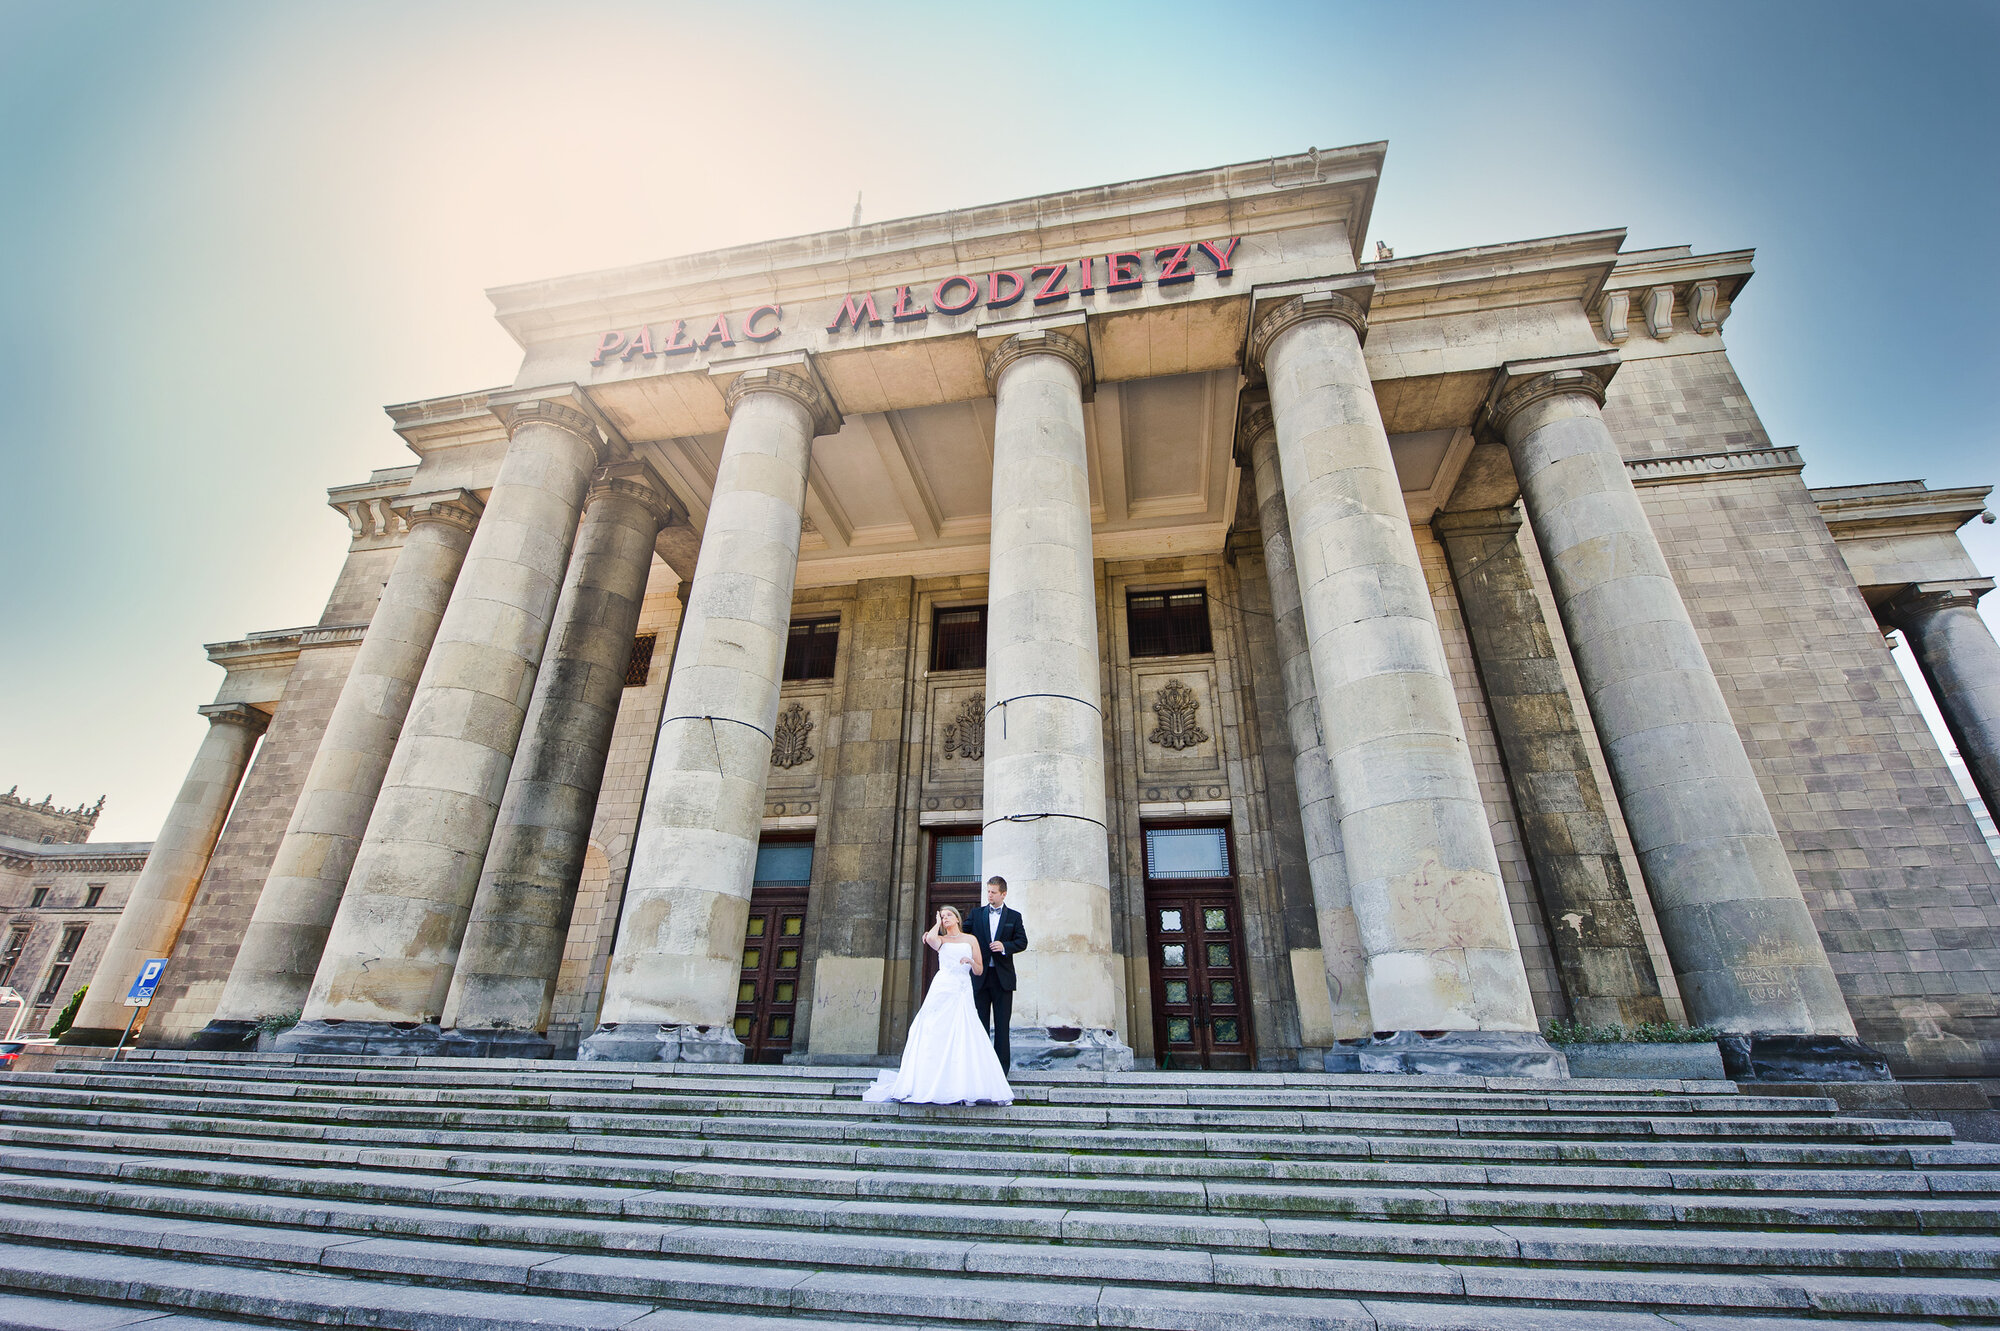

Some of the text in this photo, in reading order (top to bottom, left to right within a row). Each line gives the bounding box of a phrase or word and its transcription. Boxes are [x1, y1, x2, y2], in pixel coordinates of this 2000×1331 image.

[590, 304, 783, 367] PAŁAC
[138, 962, 162, 987] P
[1746, 986, 1787, 1000] KUBA
